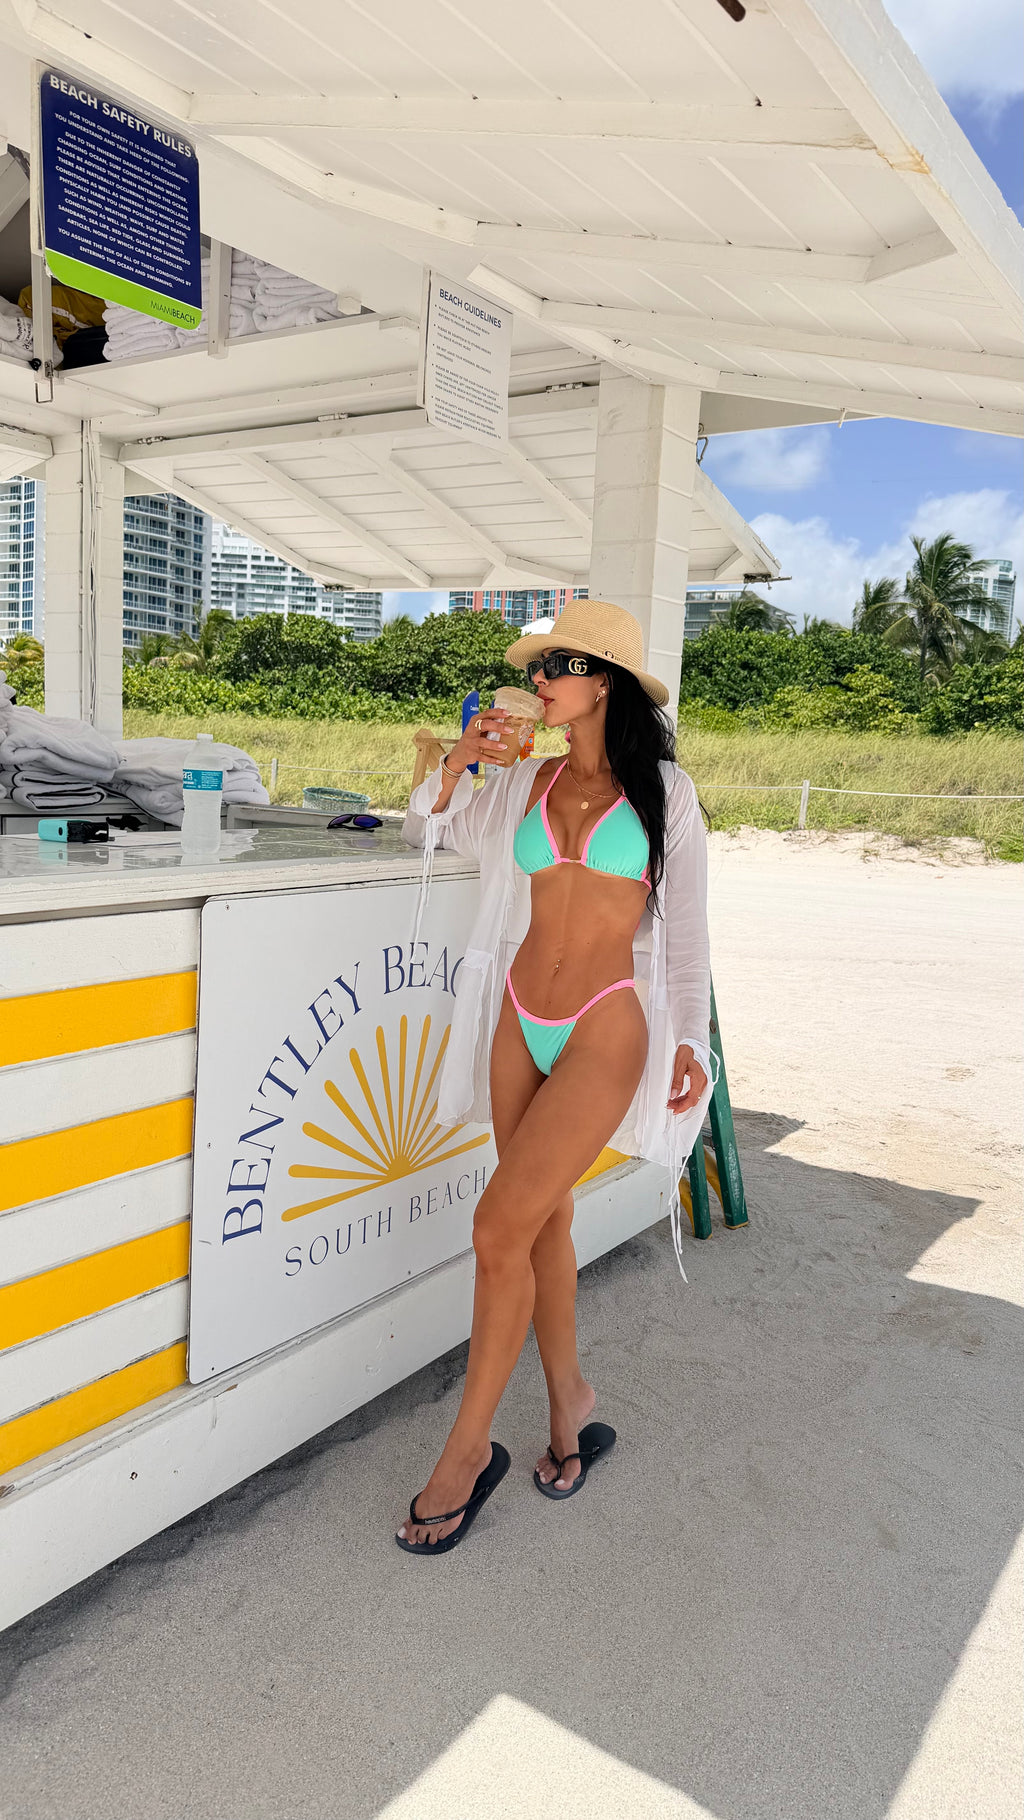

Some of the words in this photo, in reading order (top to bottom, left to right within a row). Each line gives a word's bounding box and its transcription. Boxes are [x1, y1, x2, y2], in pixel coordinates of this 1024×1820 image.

[49, 74, 97, 110] BEACH
[102, 102, 149, 137] SAFETY
[153, 129, 192, 159] RULES
[54, 112, 66, 123] YOU
[67, 118, 103, 141] UNDERSTAND
[103, 136, 115, 147] AND
[116, 143, 128, 153] TAKE
[129, 149, 142, 160] HEED
[150, 160, 159, 169] THE
[69, 110, 80, 120] FOR
[81, 116, 95, 128] YOUR
[96, 124, 110, 135] OWN
[111, 131, 128, 144] SAFETY
[140, 146, 163, 162] REQUIRED
[164, 158, 176, 168] THAT
[56, 146, 75, 159] PLEASE
[84, 158, 106, 174] ADVISED
[121, 176, 136, 188] WHEN
[137, 184, 161, 200] ENTERING
[162, 196, 170, 204] THE
[57, 136, 88, 155] CHANGING
[109, 161, 121, 171] SURF
[122, 168, 153, 187] CONDITIONS
[153, 183, 164, 192] AND
[58, 156, 74, 168] THERE
[75, 164, 85, 173] ARE
[86, 169, 114, 187] NATURALLY
[146, 197, 188, 221] UNCONTROLLABLE
[65, 131, 76, 141] DUE
[86, 141, 95, 150] THE
[96, 146, 121, 163] INHERENT
[122, 159, 143, 173] DANGER
[151, 173, 180, 191] CONSTANTLY
[55, 165, 89, 185] CONDITIONS
[98, 184, 110, 195] WELL
[119, 194, 143, 210] INHERENT
[144, 206, 158, 216] RISKS
[158, 212, 174, 224] WHICH
[175, 220, 190, 231] COULD
[59, 176, 89, 194] PHYSICALLY
[90, 190, 105, 201] HARM
[106, 197, 117, 206] YOU
[132, 209, 154, 223] POSSIBLY
[154, 219, 169, 230] CAUSE
[64, 187, 78, 198] SUCH
[145, 224, 157, 233] SURF
[158, 229, 169, 238] AND
[169, 234, 184, 245] WATER
[64, 197, 98, 216] CONDITIONS
[106, 216, 119, 226] WELL
[128, 225, 148, 238] AMONG
[149, 234, 164, 246] OTHER
[58, 227, 70, 236] YOU
[70, 232, 91, 245] ASSUME
[92, 241, 102, 250] THE
[103, 246, 114, 255] RISK
[123, 254, 132, 262] ALL
[140, 261, 154, 271] THESE
[155, 267, 184, 284] CONDITIONS
[79, 245, 105, 260] ENTERING
[106, 256, 115, 264] THE
[116, 260, 134, 272] OCEAN
[134, 268, 145, 277] AND
[88, 217, 98, 226] SEA
[111, 227, 121, 236] RED
[135, 237, 151, 248] GLASS
[151, 244, 162, 254] AND
[162, 249, 190, 266] SUBMERGED
[92, 228, 107, 239] NONE
[116, 238, 134, 250] WHICH
[134, 246, 145, 255] CAN
[440, 288, 462, 308] BEACH
[464, 302, 502, 328] GUIDELINES
[222, 962, 362, 1246] BENTLEY
[382, 942, 465, 998] BEAC
[285, 1206, 393, 1277] SOUTH
[408, 1166, 487, 1224] BEACH
